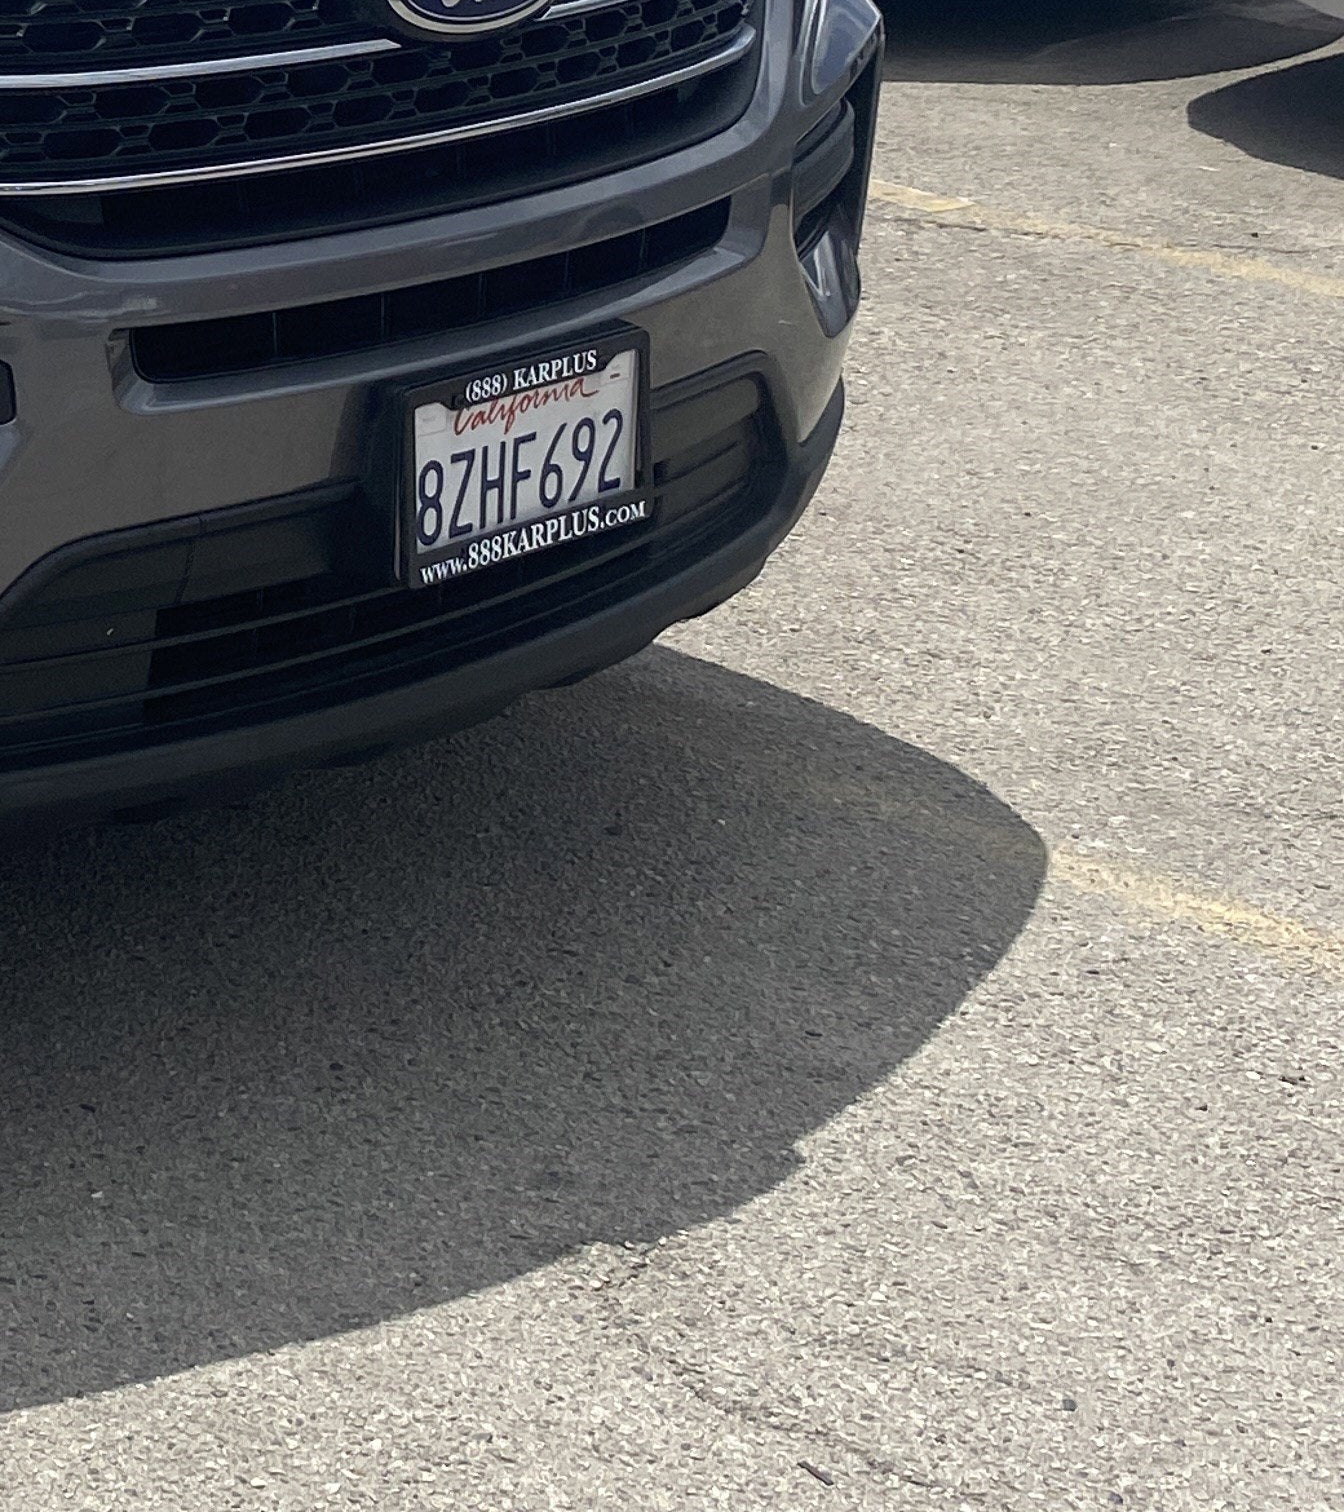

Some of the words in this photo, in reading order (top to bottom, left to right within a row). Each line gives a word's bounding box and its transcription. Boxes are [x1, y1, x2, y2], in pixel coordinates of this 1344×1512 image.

[453, 376, 600, 436] California
[465, 373, 508, 403] (888)
[512, 349, 598, 391] KARPLUS
[416, 407, 624, 546] 8ZHF692
